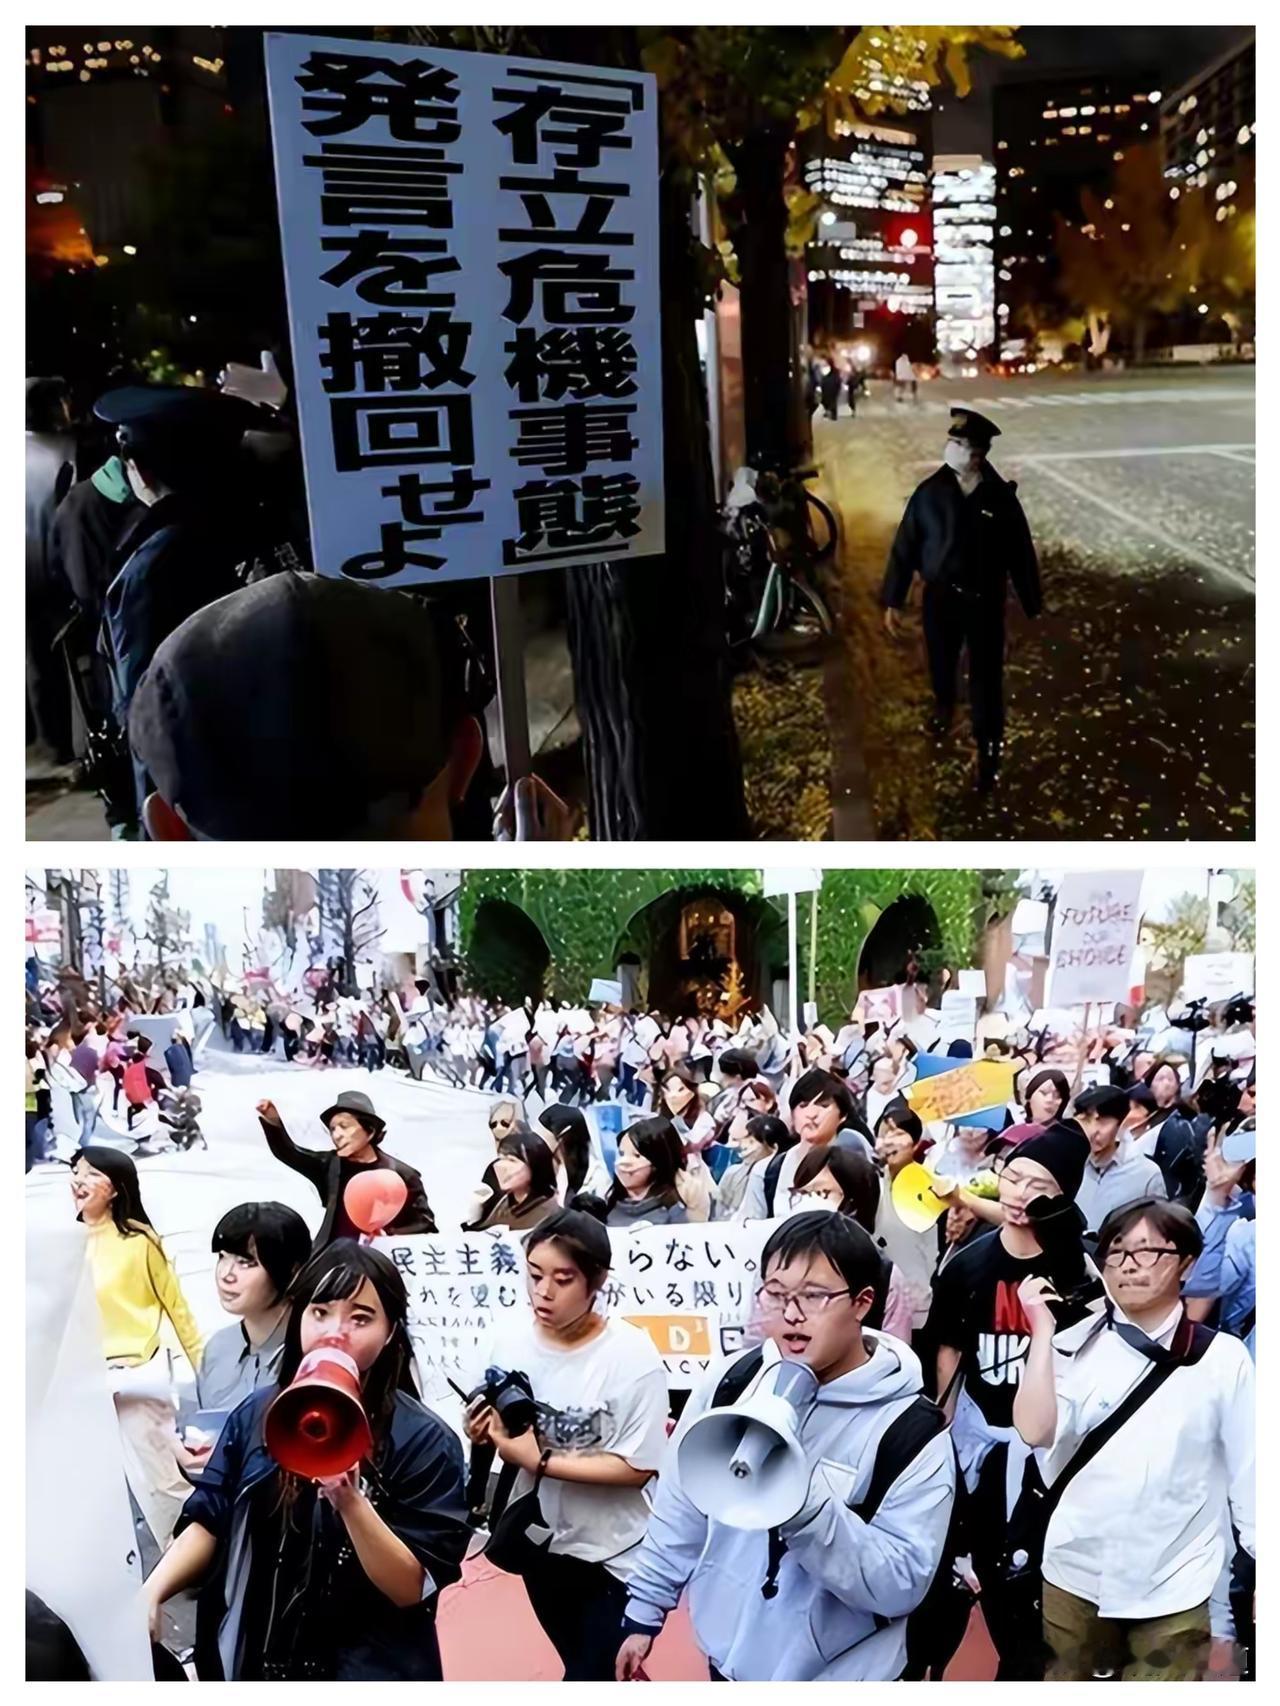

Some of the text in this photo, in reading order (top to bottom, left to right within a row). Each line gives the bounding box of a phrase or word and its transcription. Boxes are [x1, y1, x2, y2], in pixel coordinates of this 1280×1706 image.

[294, 51, 491, 579] 発言を撤回せよ
[492, 67, 643, 566] 「存立危機事態」
[391, 1238, 757, 1276] 民主主義 らない。
